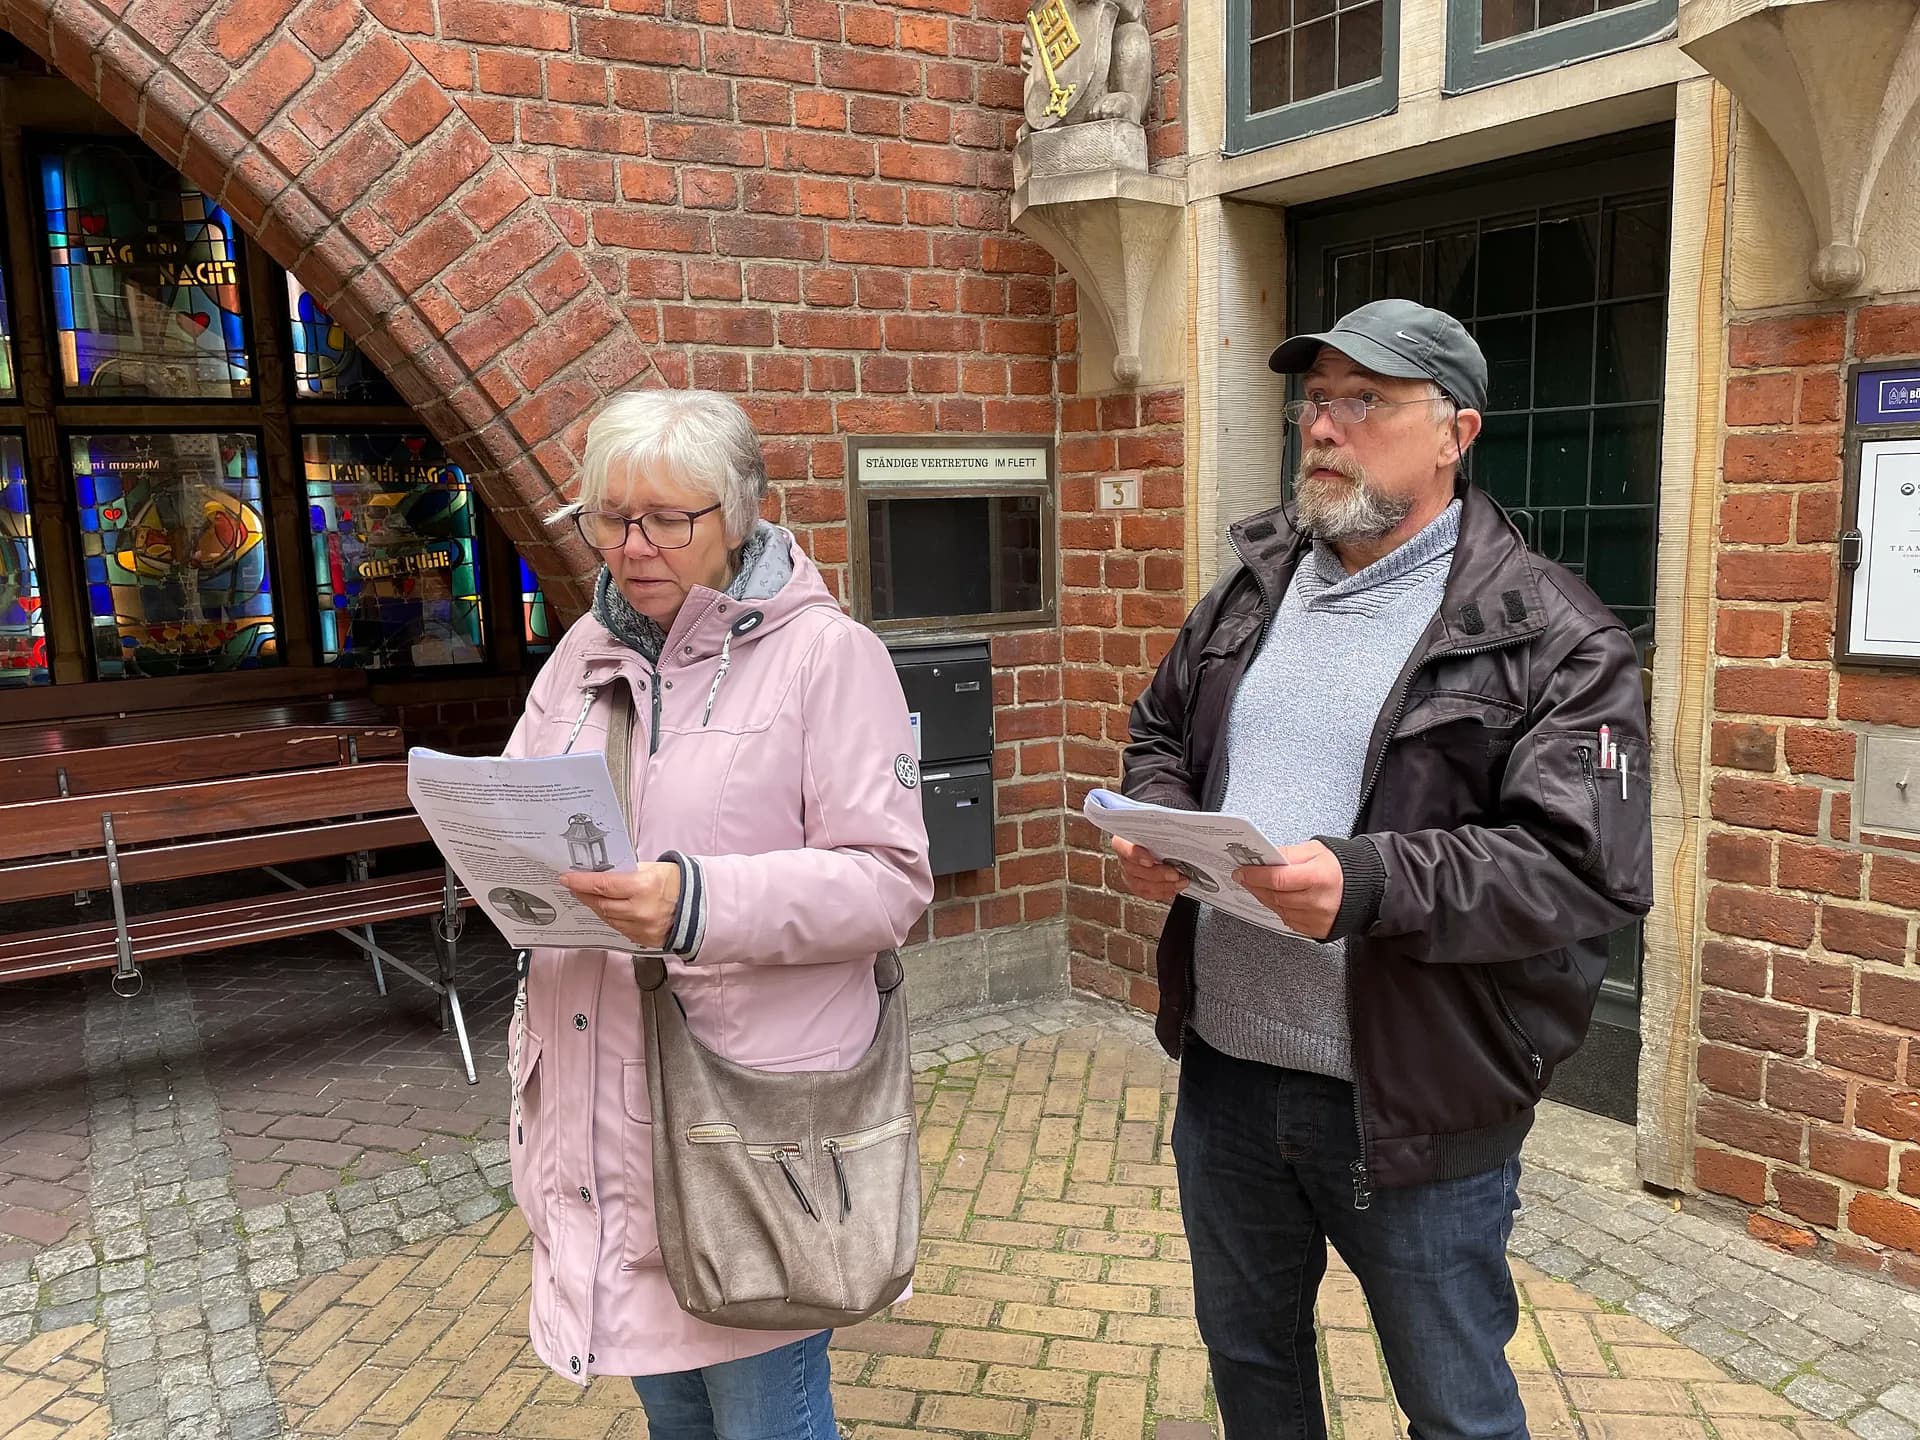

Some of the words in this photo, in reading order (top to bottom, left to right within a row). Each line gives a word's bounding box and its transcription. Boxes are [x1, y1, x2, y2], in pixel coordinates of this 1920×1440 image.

[87, 243, 134, 264] TAG
[159, 261, 236, 286] NACHT
[866, 456, 918, 468] STÄNDIGE
[921, 458, 988, 468] VERTRETUNG
[995, 458, 1005, 468] IM
[1008, 458, 1036, 468] FLETT
[1112, 482, 1124, 505] 3
